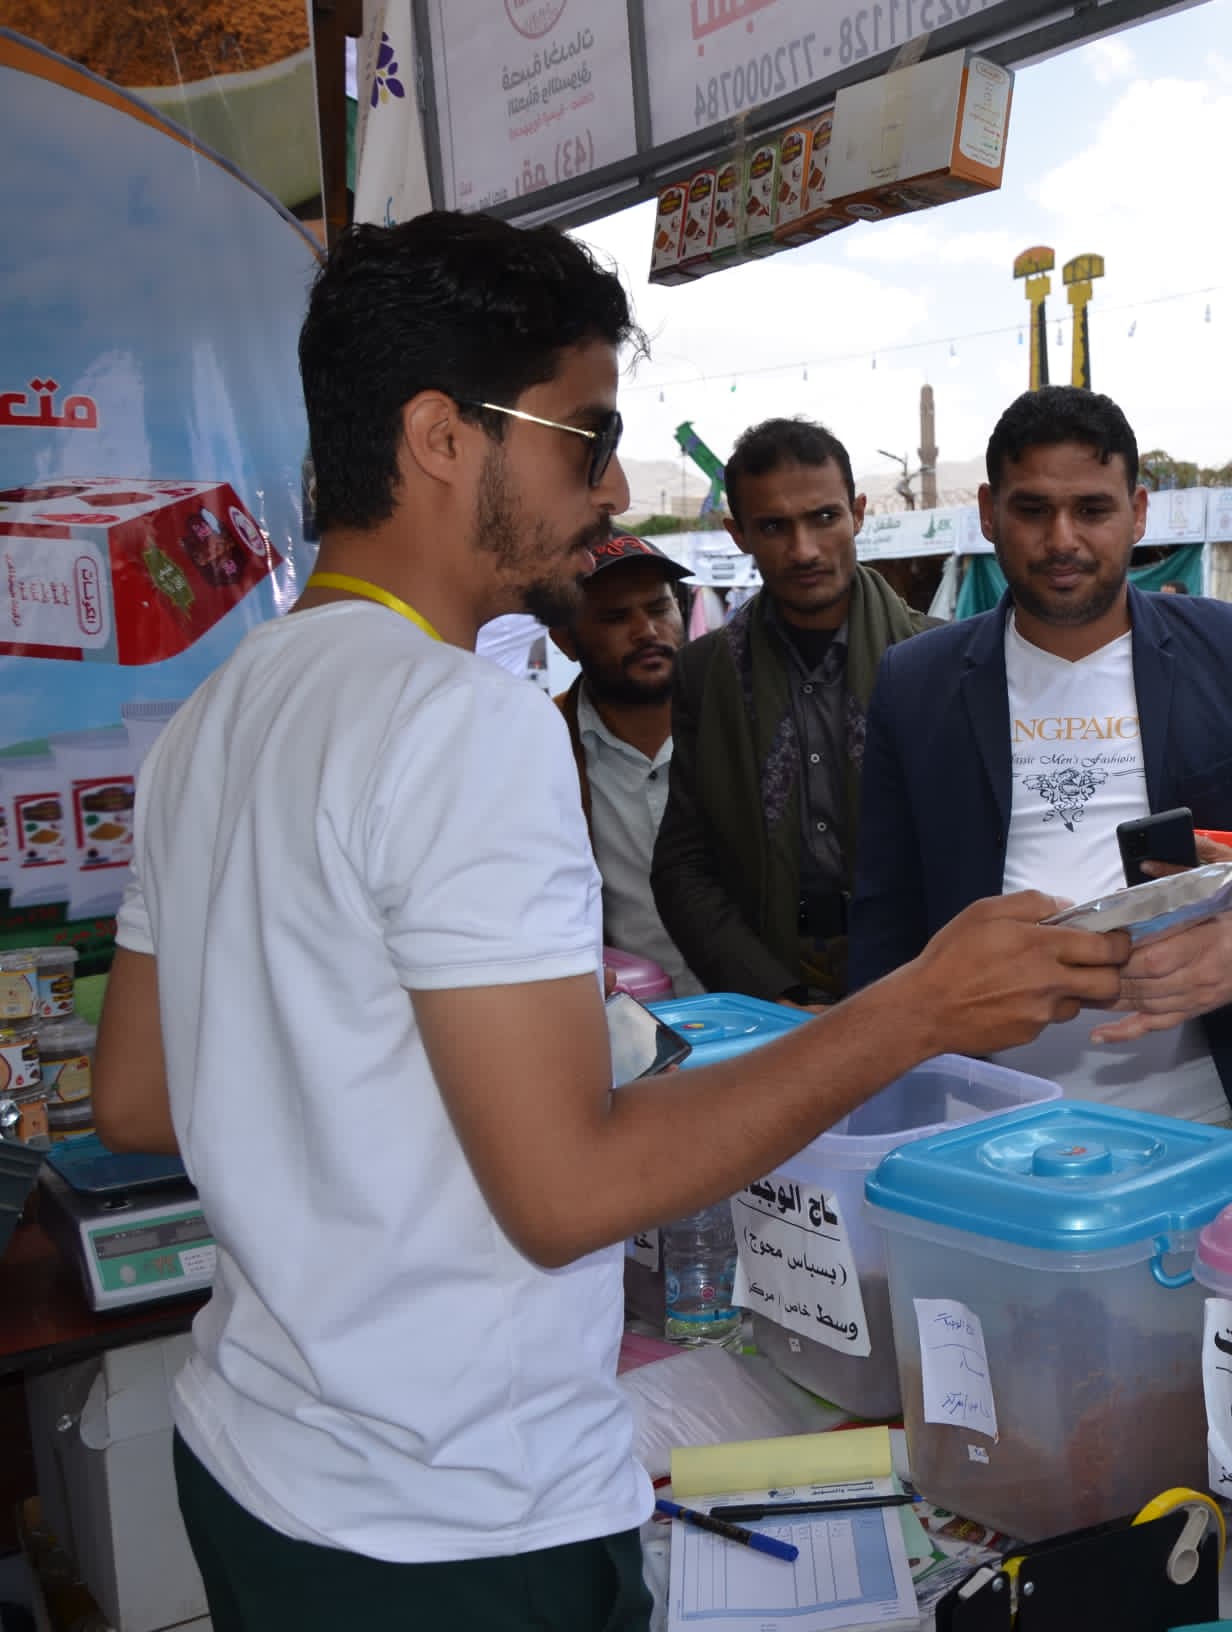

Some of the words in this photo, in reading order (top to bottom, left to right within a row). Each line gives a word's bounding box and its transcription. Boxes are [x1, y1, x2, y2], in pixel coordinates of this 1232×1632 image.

[81, 568, 97, 624] المكونات
[744, 1178, 802, 1215] الوجب
[784, 1303, 812, 1317] خاص
[815, 1303, 859, 1341] وسط
